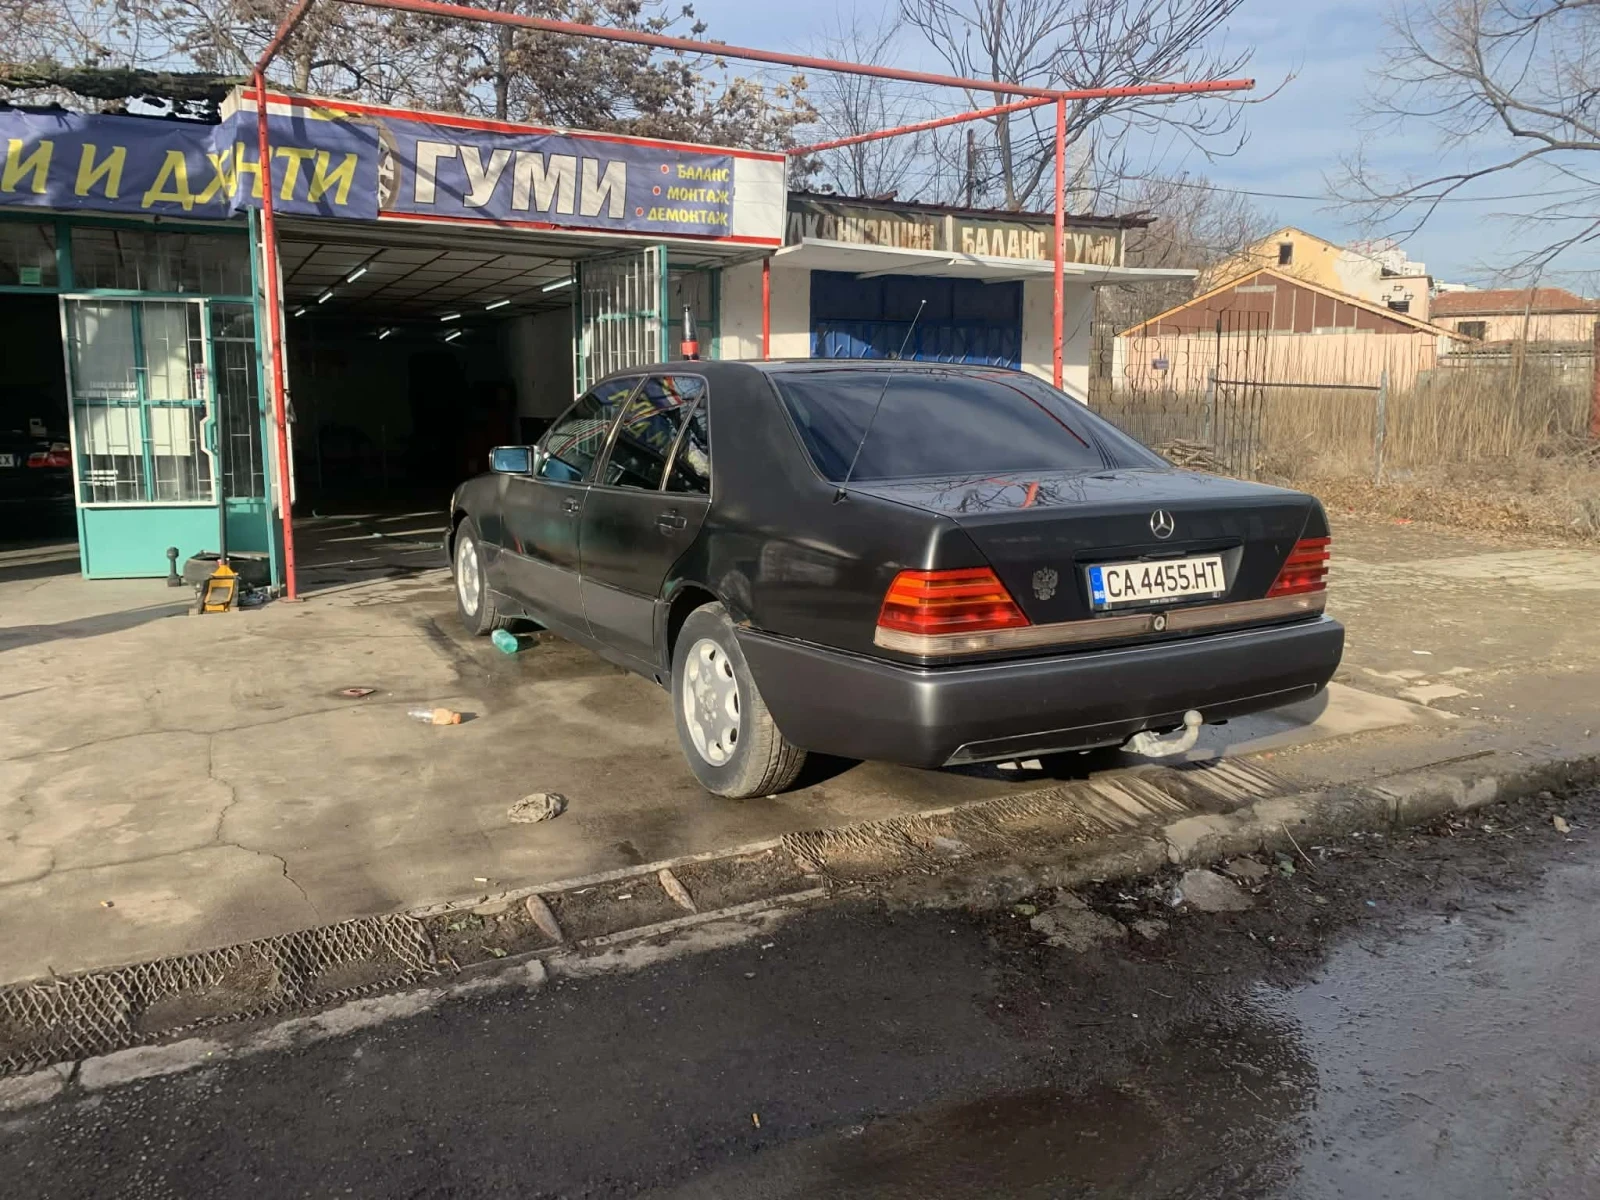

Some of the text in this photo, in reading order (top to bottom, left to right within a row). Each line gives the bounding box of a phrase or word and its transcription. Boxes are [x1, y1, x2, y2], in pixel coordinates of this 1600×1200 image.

[74, 144, 126, 198] И
[414, 140, 627, 219] ГУМИ
[676, 164, 730, 182] БАЛАНС
[667, 186, 730, 205] МОНТАЖ
[646, 206, 729, 227] ДЕМОНТАЖ
[961, 227, 1047, 261] БАЛАНС
